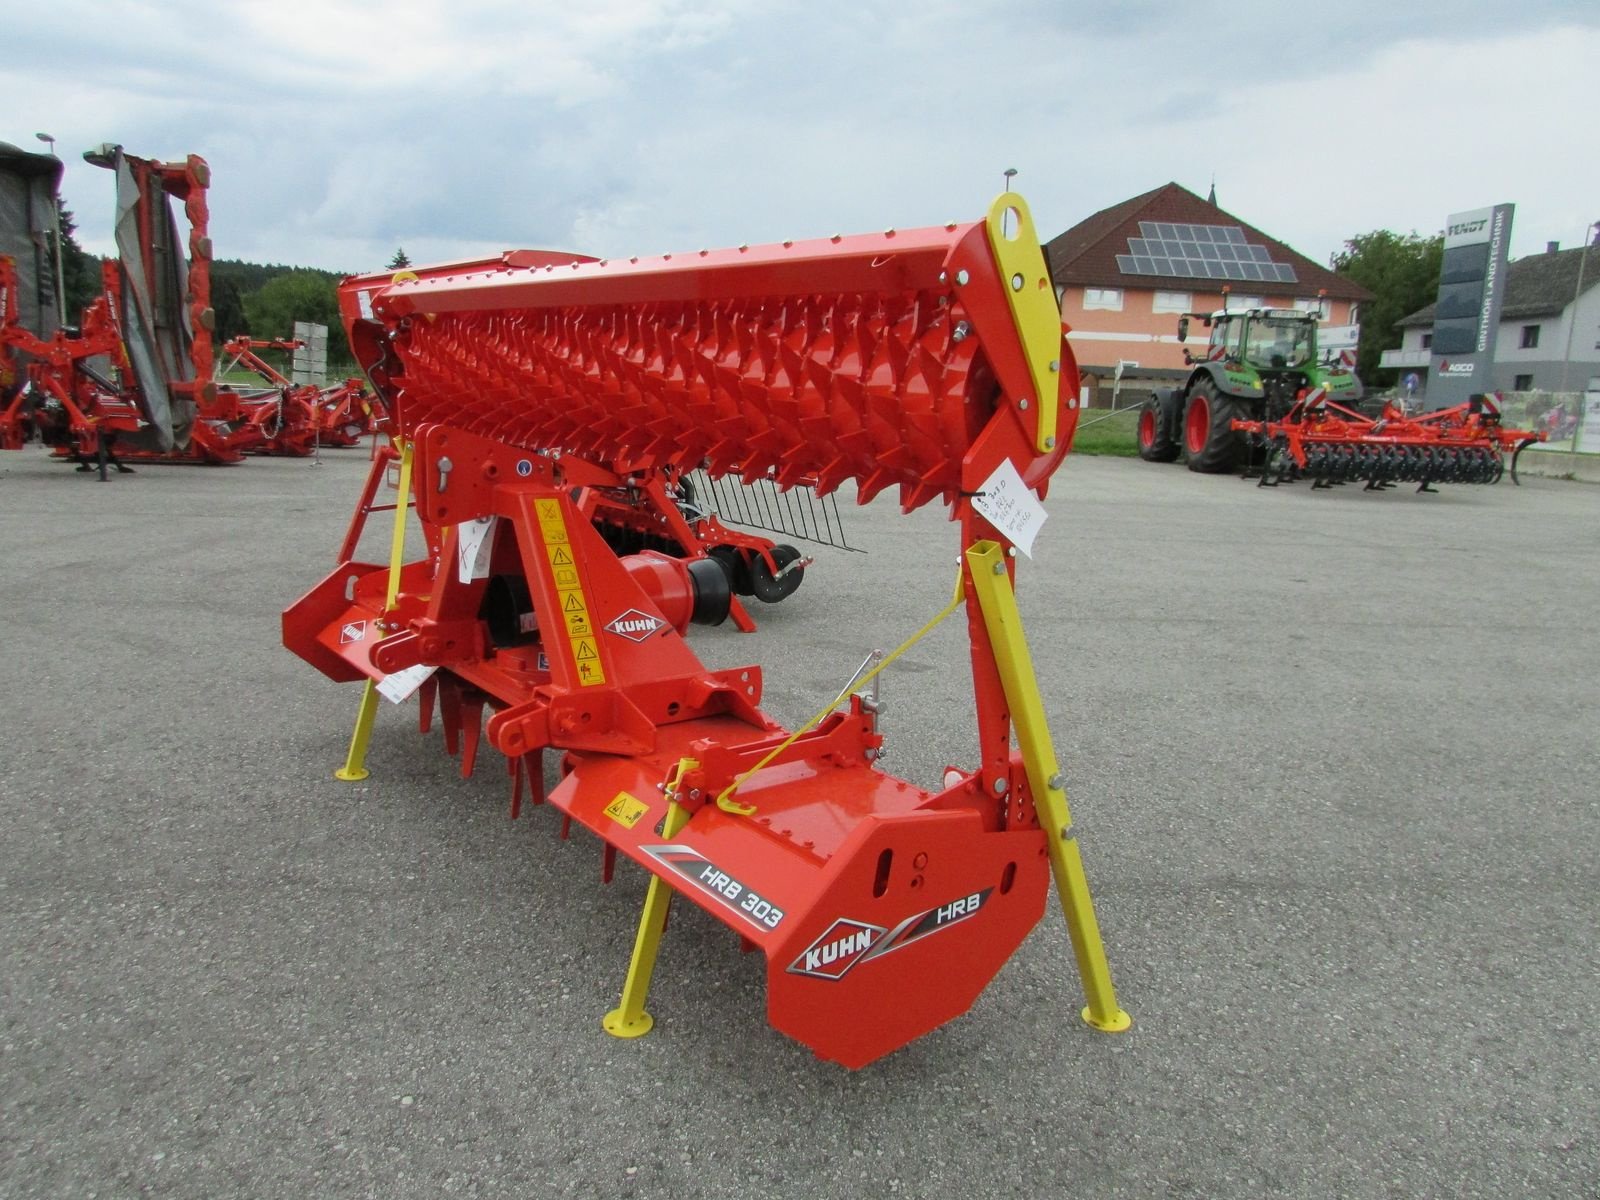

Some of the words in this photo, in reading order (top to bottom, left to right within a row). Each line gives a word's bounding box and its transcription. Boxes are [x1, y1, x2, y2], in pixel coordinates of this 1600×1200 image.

[1448, 219, 1487, 236] FENDT
[1487, 210, 1504, 296] LANDTECHNIK
[615, 619, 656, 633] KUHN
[699, 865, 742, 900] HRB
[741, 892, 783, 928] 303
[937, 893, 980, 924] HRB
[805, 928, 872, 972] KUHN
